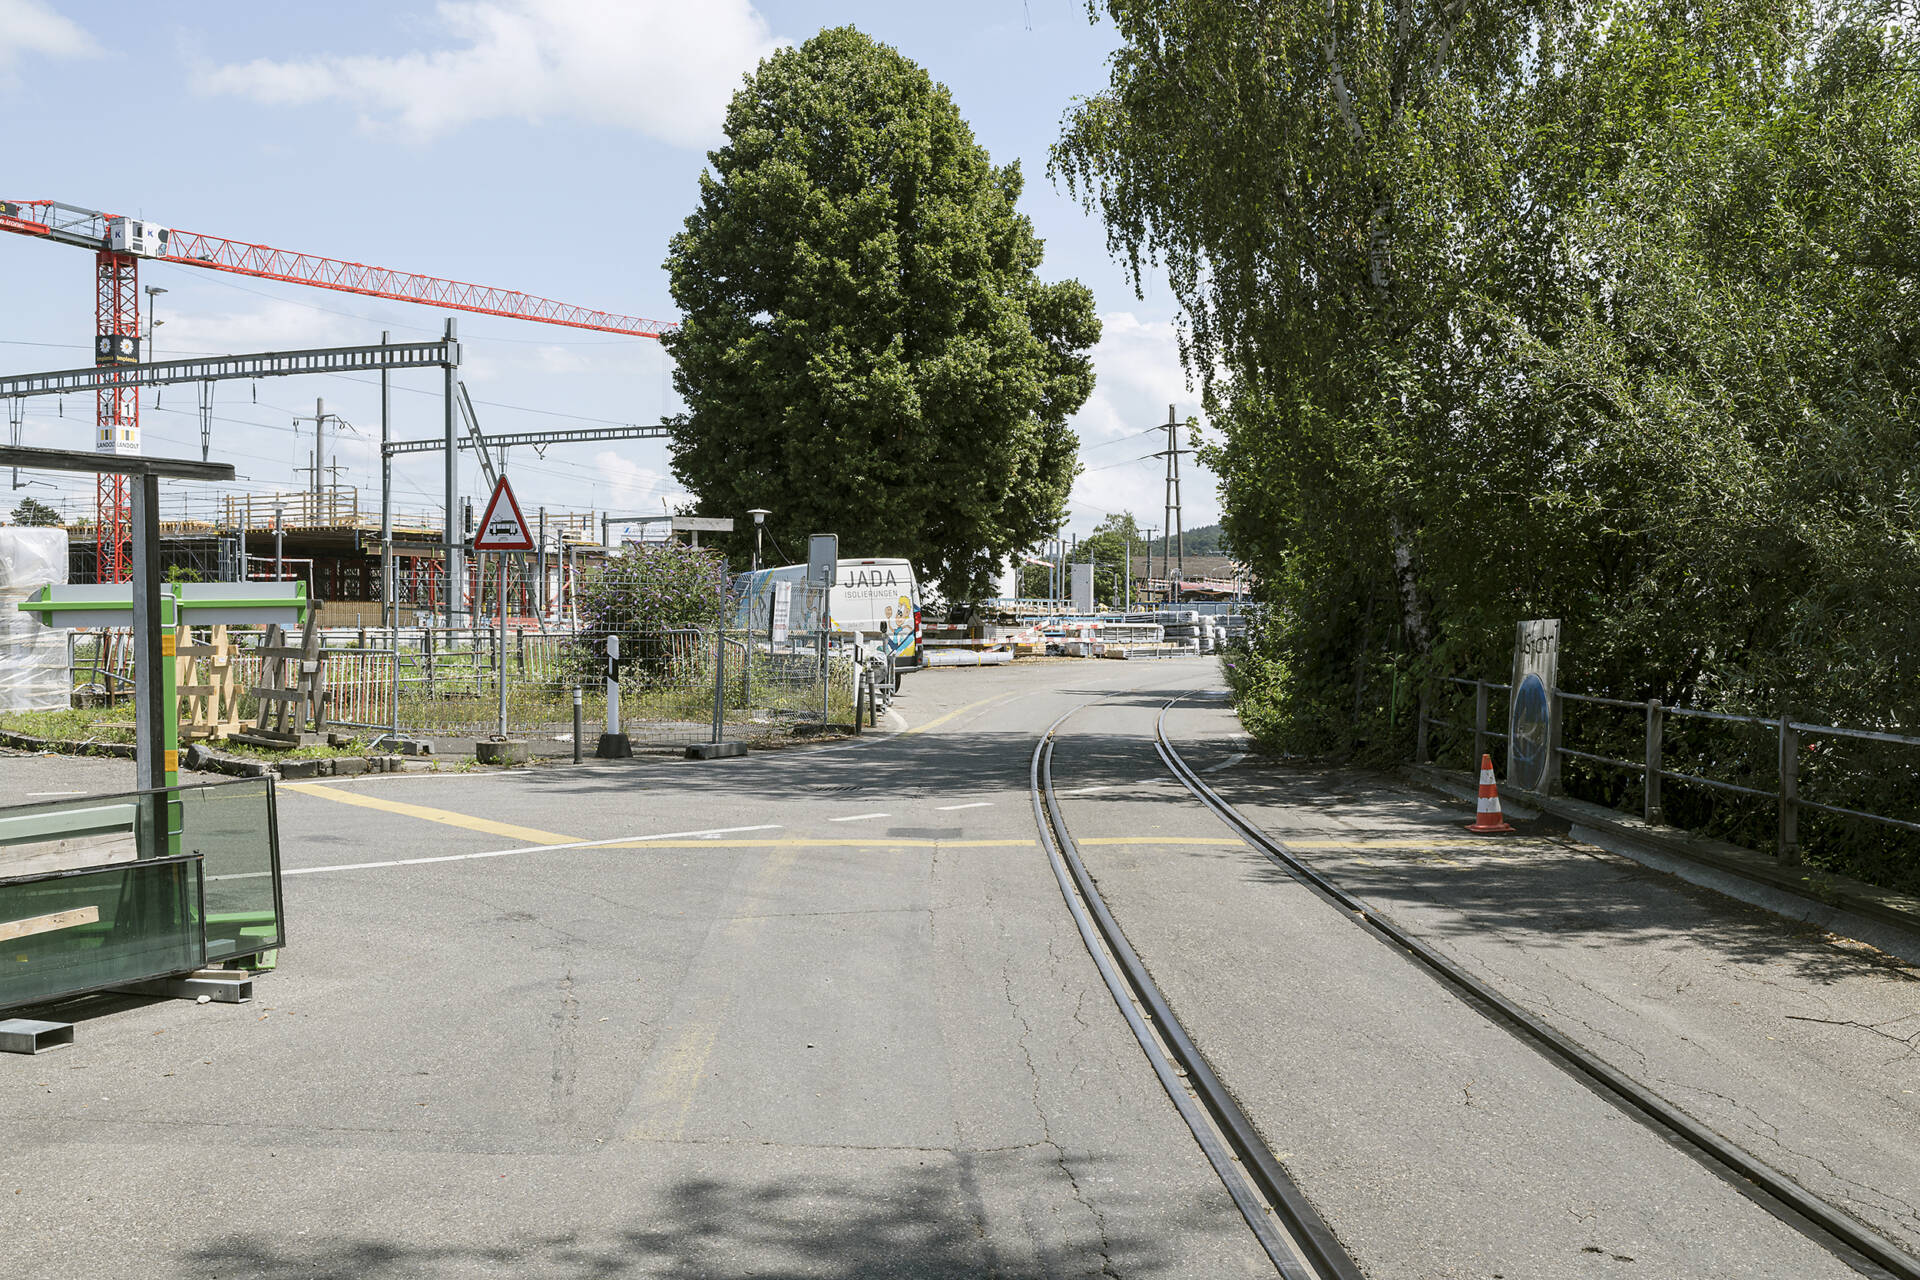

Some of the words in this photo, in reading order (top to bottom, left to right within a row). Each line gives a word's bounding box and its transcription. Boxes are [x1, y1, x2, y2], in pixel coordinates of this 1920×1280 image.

[104, 402, 109, 415] 1
[124, 403, 130, 416] 1
[844, 569, 897, 589] JADA
[844, 590, 898, 599] ISOLIERUNGEN
